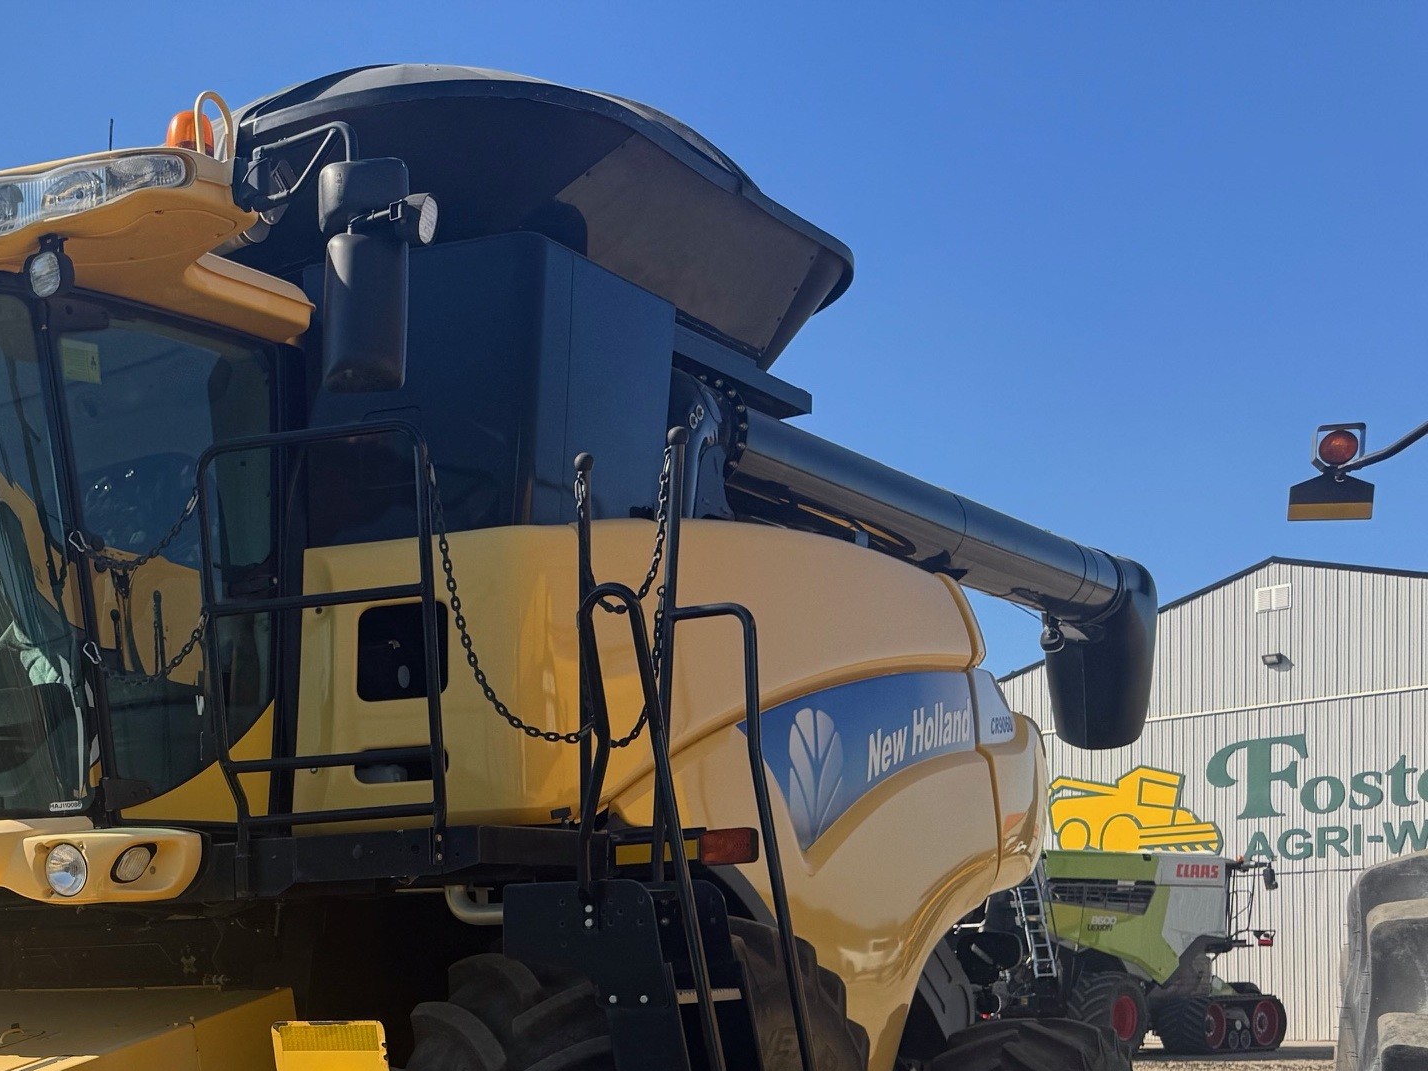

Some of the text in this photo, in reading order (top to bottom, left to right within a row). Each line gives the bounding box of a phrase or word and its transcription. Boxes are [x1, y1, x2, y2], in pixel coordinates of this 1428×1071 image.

[867, 698, 972, 783] New Holland
[1206, 733, 1428, 820] Fost
[1176, 863, 1219, 879] CLAAS
